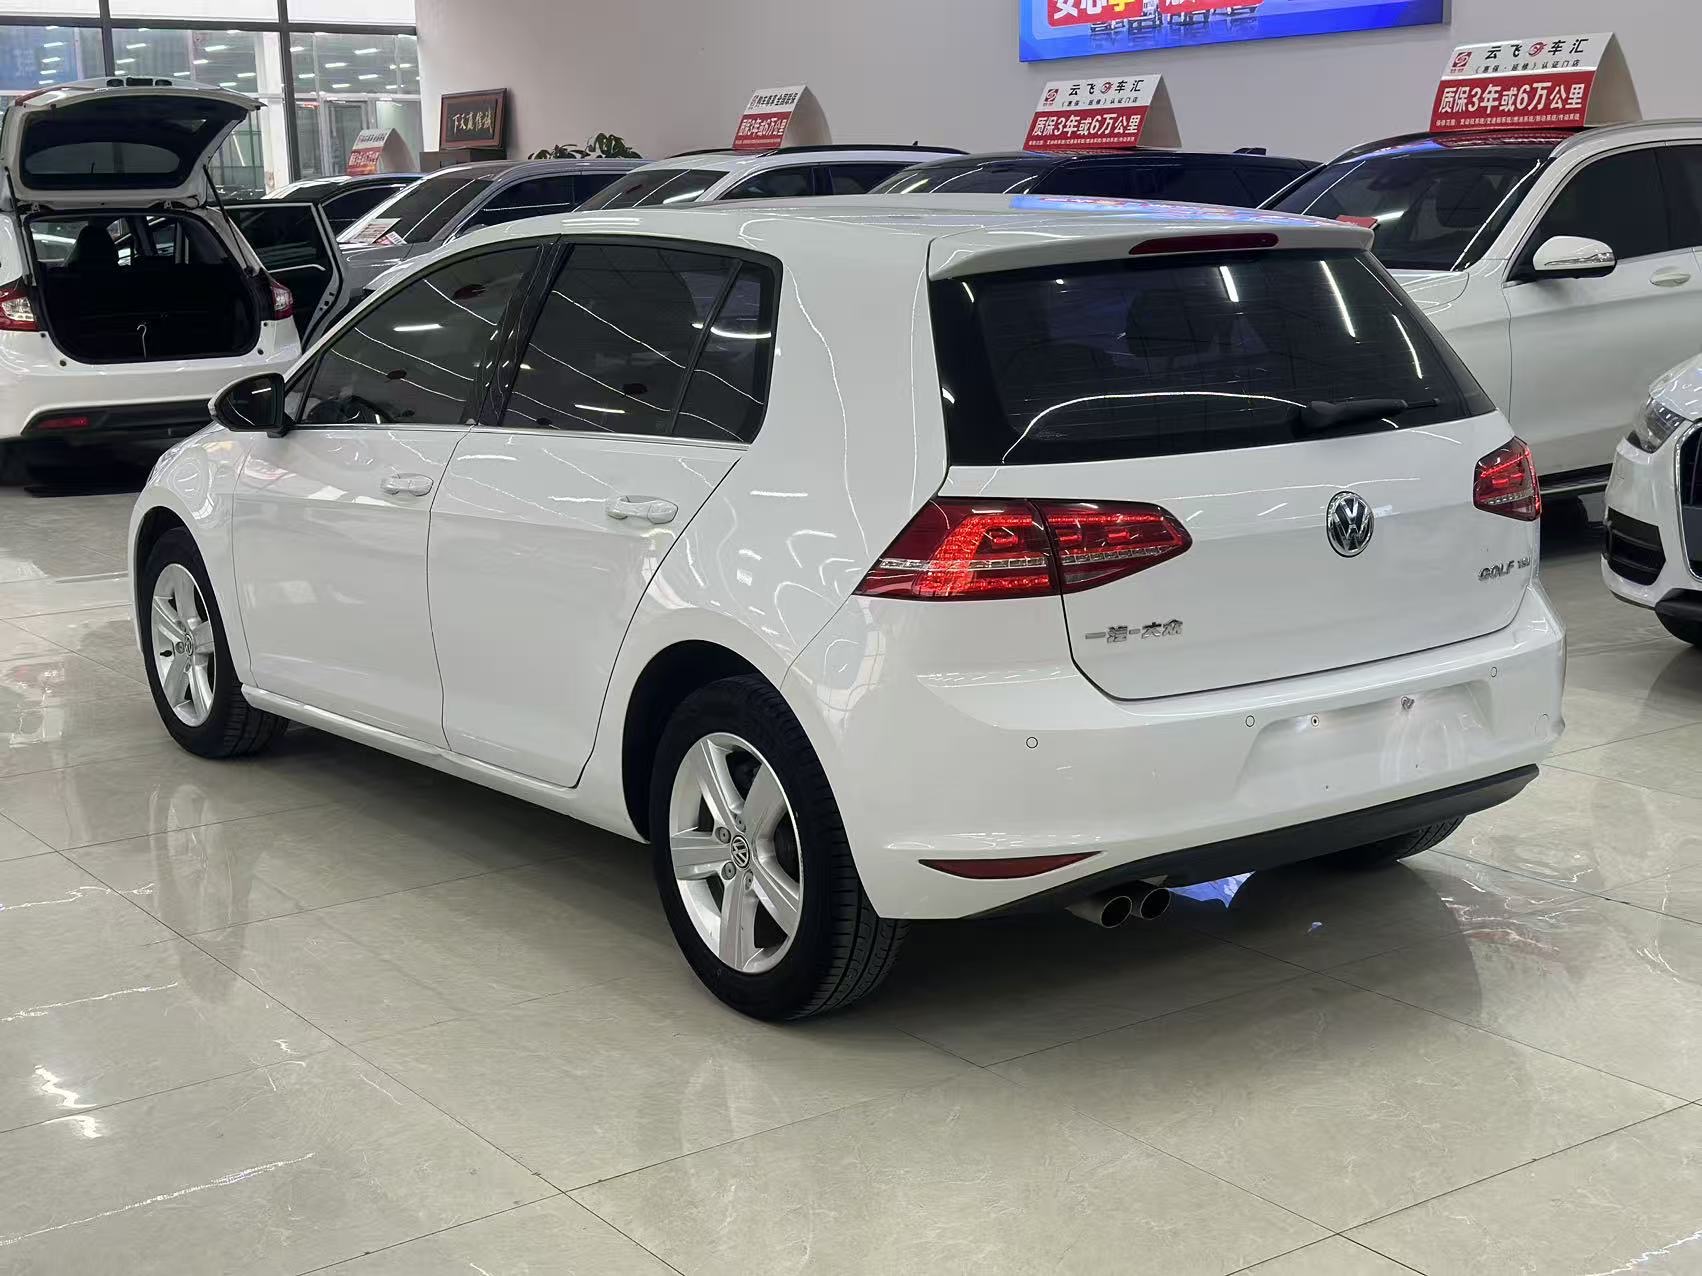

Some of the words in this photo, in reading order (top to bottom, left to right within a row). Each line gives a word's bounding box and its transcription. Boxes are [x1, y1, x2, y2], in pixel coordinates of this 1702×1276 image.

[1438, 82, 1585, 114] 质保3年或6万公里
[1032, 113, 1141, 137] 质保3年或6万公里
